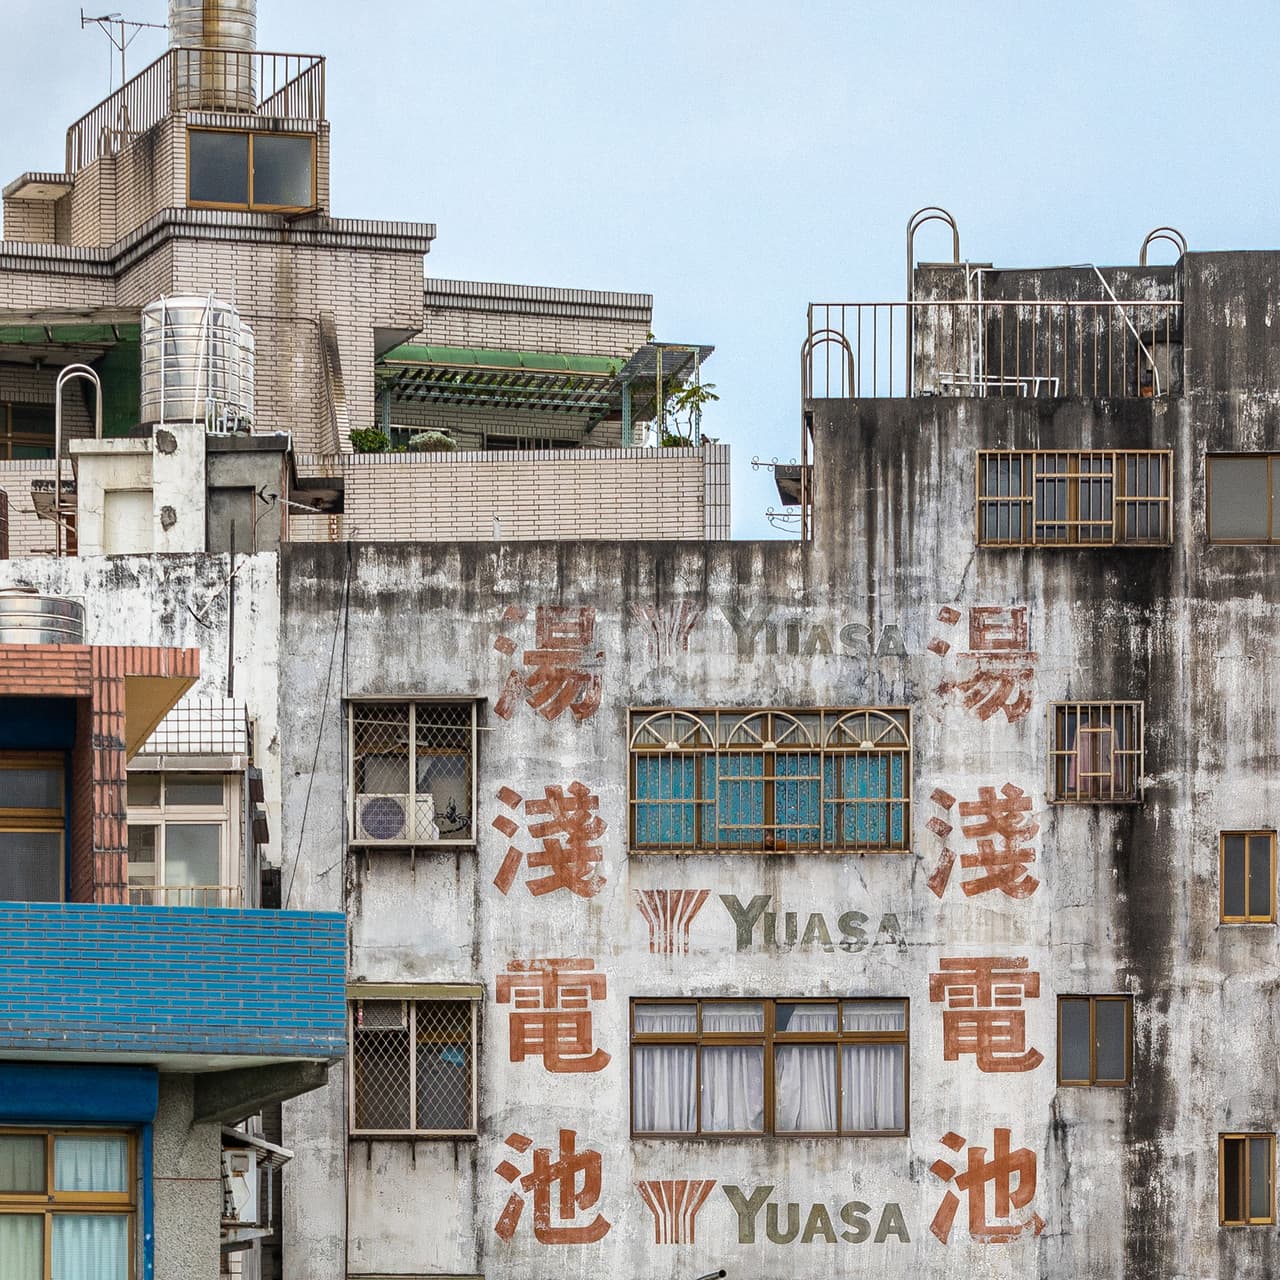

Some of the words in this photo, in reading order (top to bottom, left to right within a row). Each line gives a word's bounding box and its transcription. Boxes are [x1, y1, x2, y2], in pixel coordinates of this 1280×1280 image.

[493, 605, 612, 1246] 湯淺電池
[719, 893, 908, 954] YUASA
[927, 605, 1046, 1246] 湯淺電池
[723, 1184, 911, 1246] YUASA
